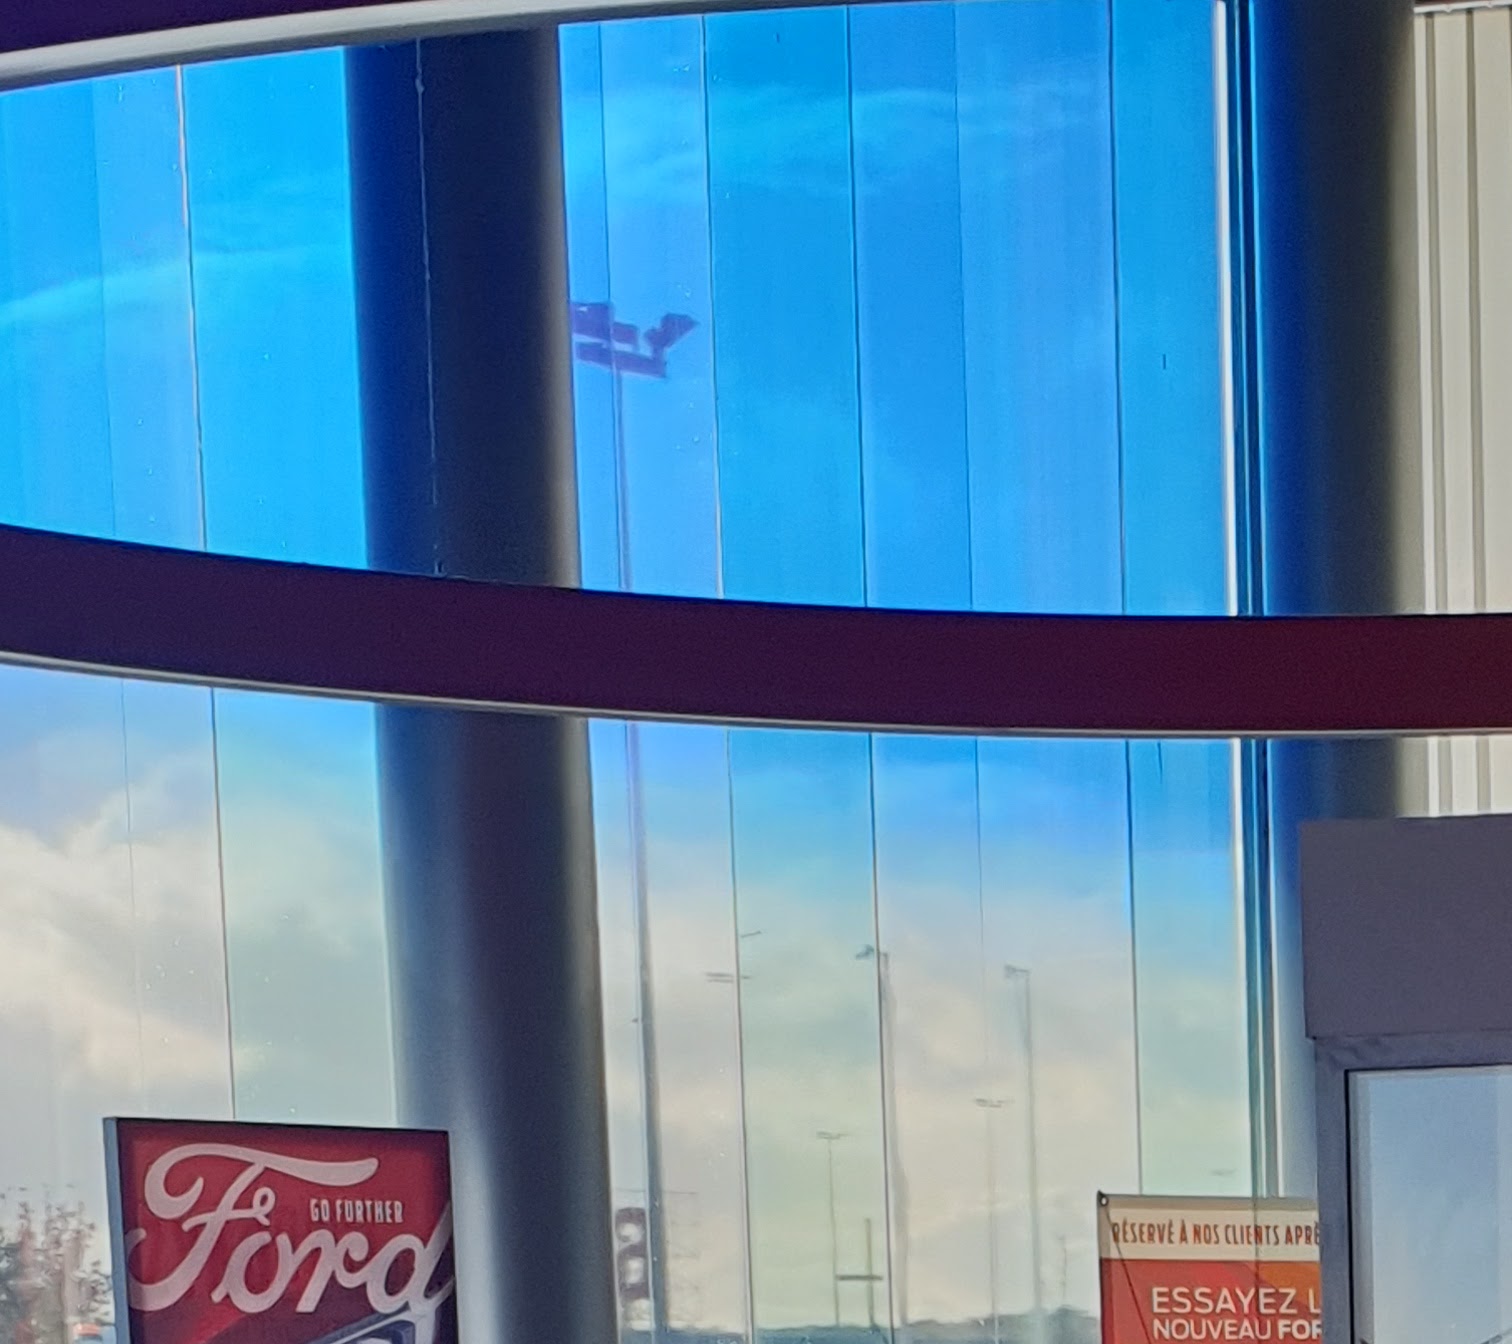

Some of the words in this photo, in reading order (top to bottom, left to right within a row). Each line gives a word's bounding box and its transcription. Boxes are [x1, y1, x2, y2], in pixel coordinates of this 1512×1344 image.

[310, 1199, 330, 1223] GO
[335, 1200, 405, 1224] FURTHER
[124, 1143, 455, 1313] Ford
[1112, 1218, 1175, 1243] RÉSERVÉ
[1179, 1219, 1189, 1243] À
[1192, 1223, 1220, 1244] NOS
[1225, 1224, 1280, 1246] CLIENTS
[1151, 1287, 1297, 1315] ESSAYEZ
[1153, 1319, 1272, 1340] NOUVEAU
